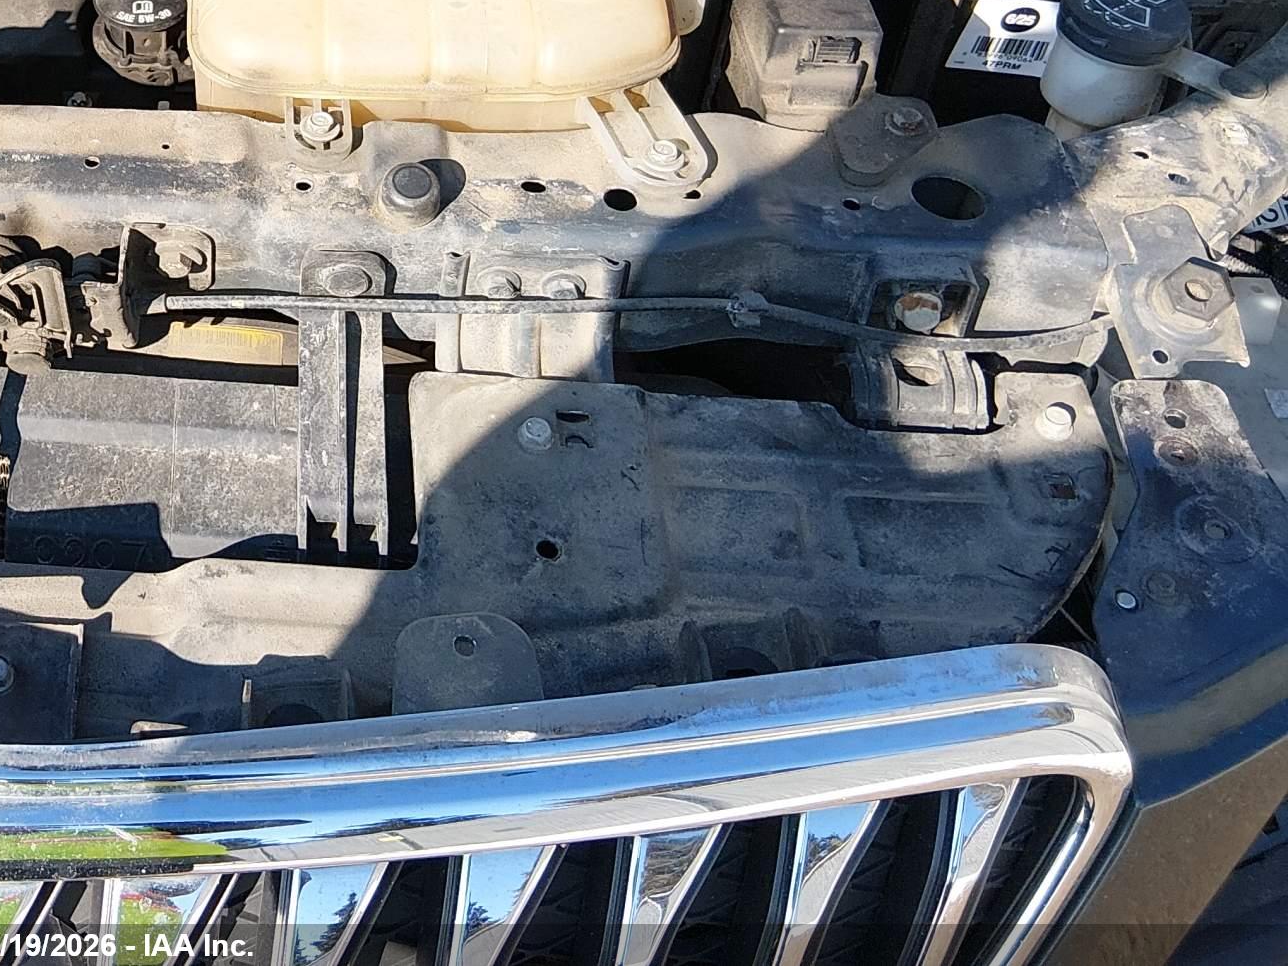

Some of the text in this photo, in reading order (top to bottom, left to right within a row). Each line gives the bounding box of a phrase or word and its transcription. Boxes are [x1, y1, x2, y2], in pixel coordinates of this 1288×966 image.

[115, 9, 172, 24] SAE 5W-30
[982, 60, 1022, 70] 47PRM
